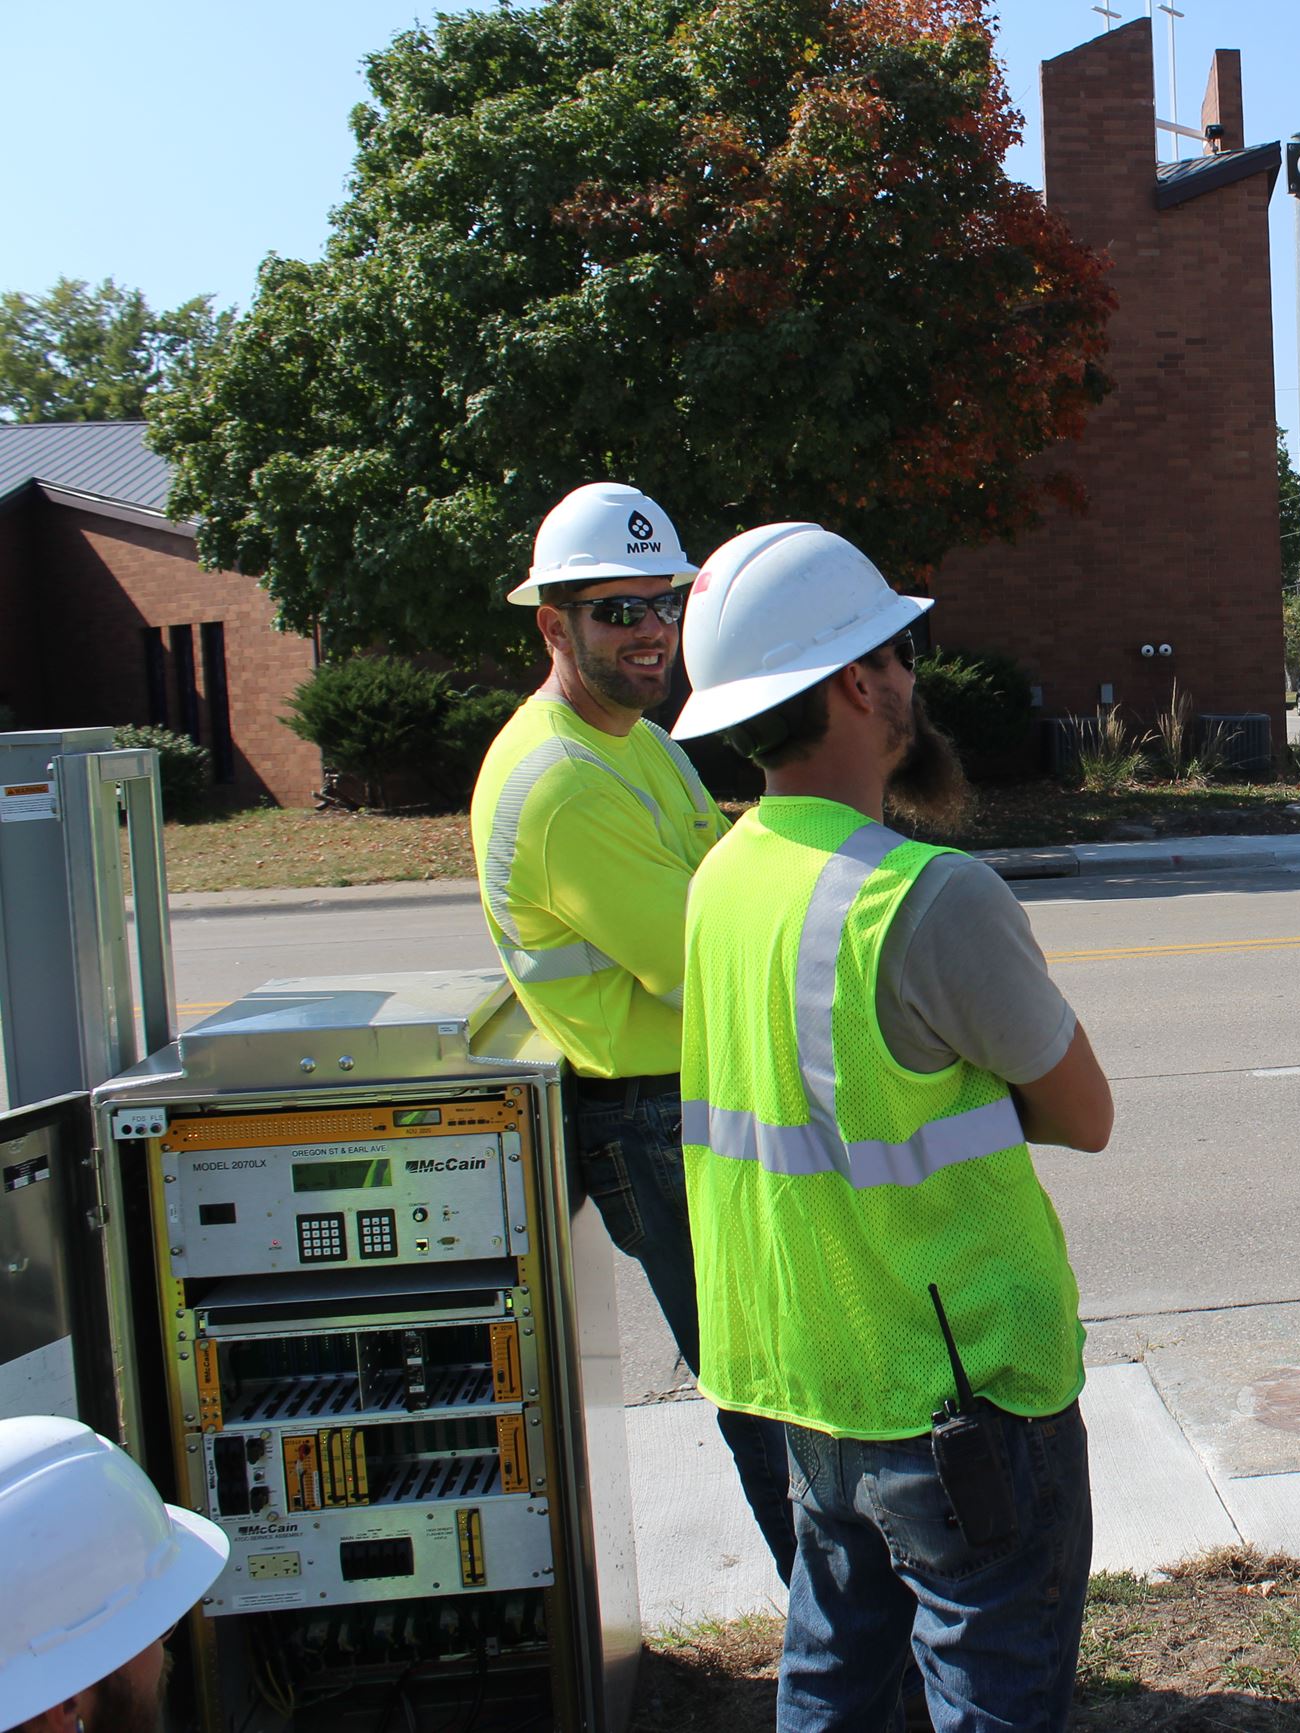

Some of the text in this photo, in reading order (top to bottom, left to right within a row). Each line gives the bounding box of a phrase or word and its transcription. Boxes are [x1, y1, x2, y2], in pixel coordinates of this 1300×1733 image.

[627, 542, 661, 554] MPW
[291, 1144, 386, 1158] OREGON ST & EARL AVE
[193, 1159, 266, 1172] MODEL 2070LX
[418, 1157, 486, 1173] McCain
[247, 1523, 298, 1536] McCain
[275, 1532, 304, 1540] ASSEMBLY
